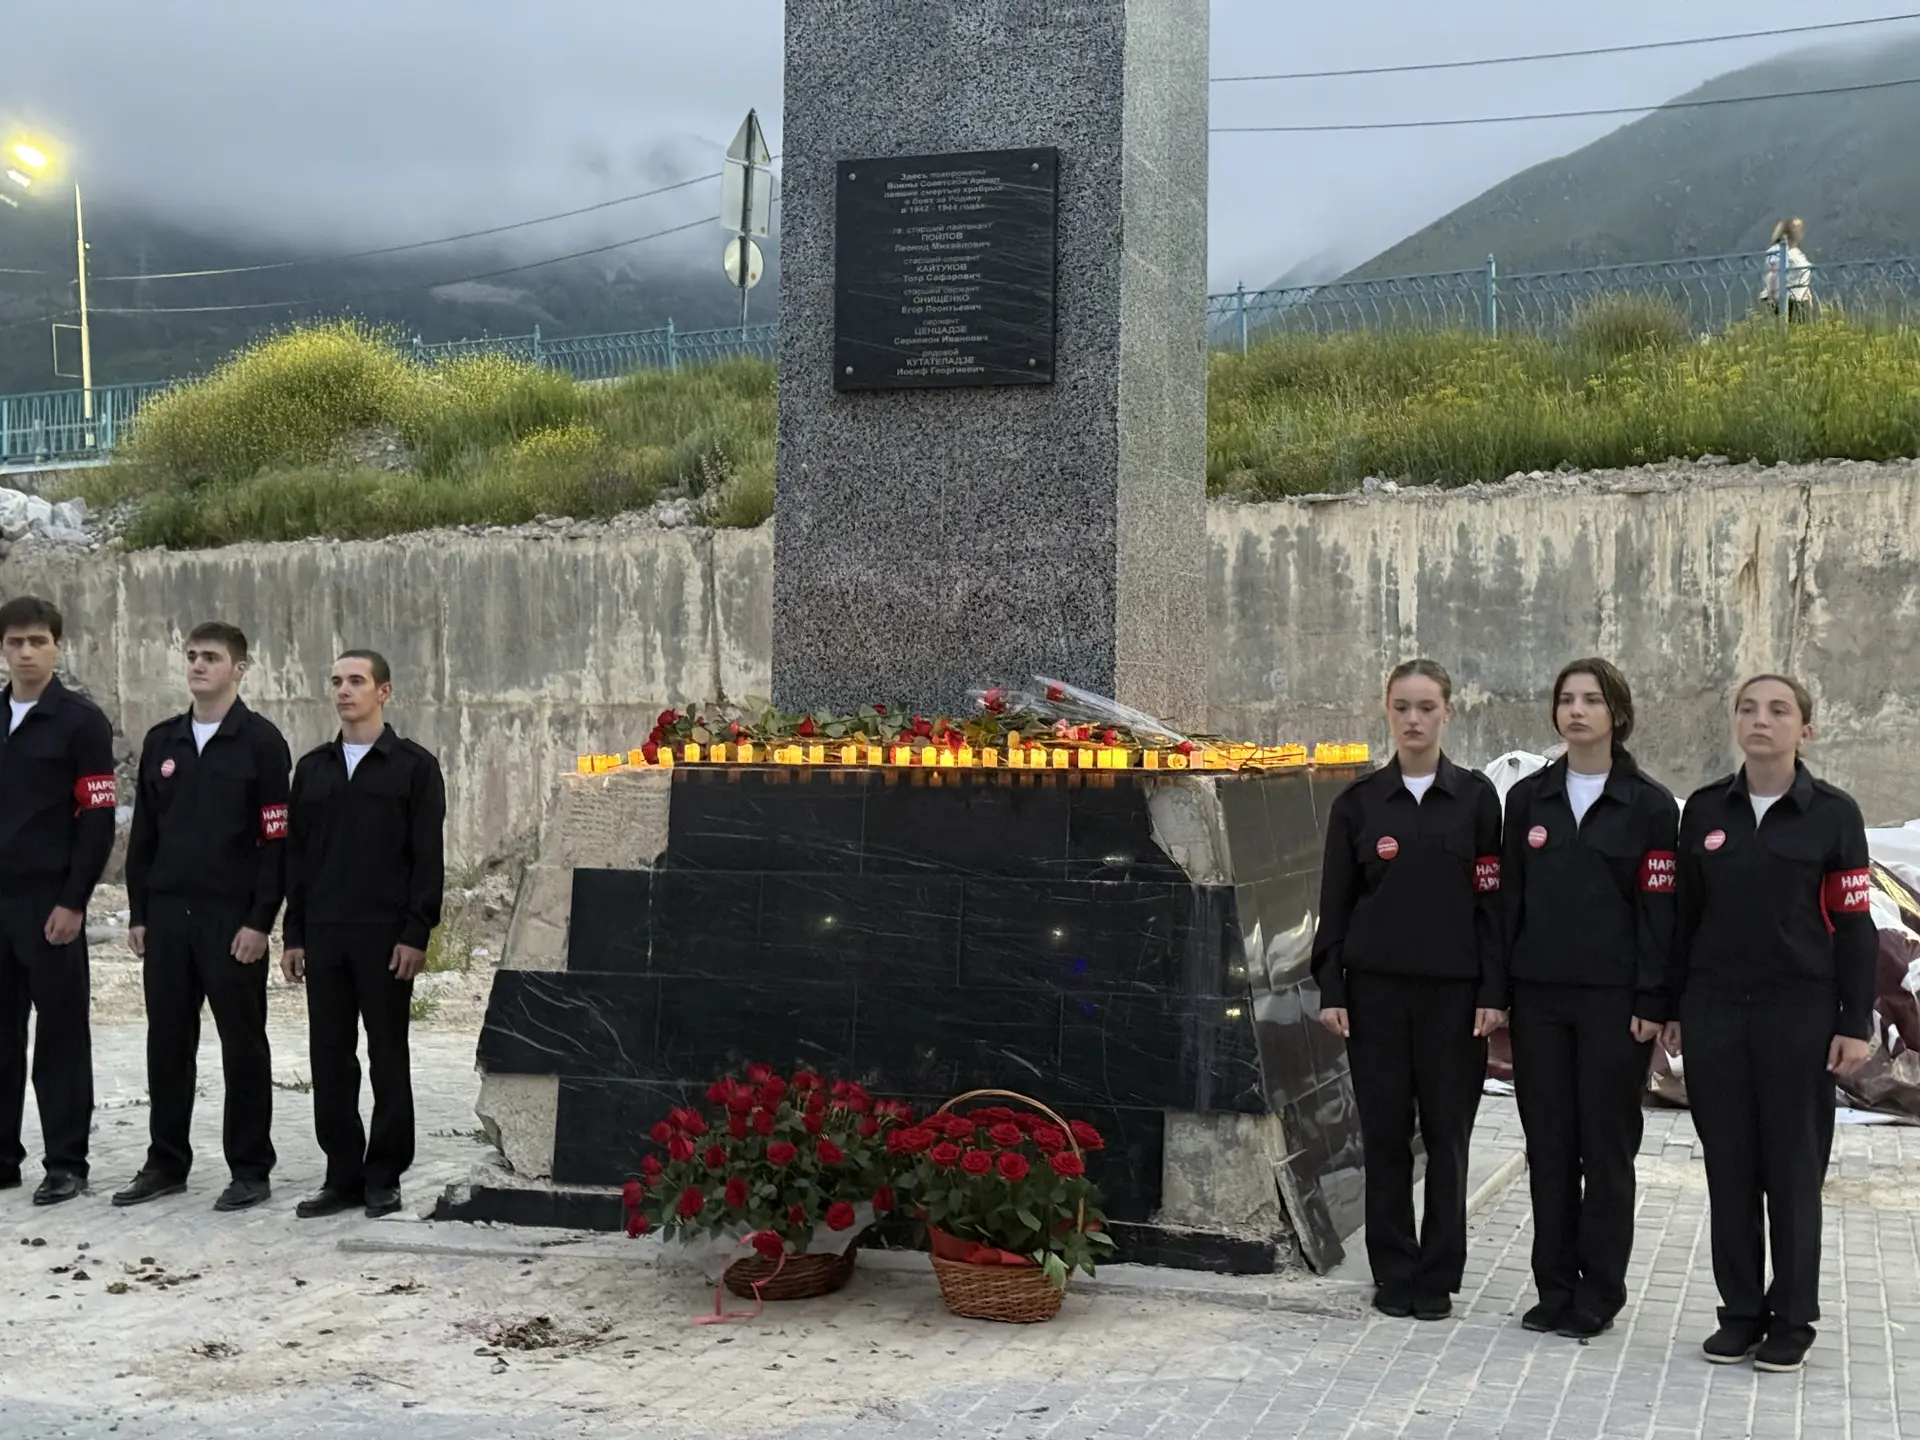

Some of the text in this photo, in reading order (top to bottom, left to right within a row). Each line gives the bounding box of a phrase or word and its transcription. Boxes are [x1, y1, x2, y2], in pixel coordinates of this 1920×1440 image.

[901, 172, 928, 181] Здесь
[887, 181, 918, 190] Воины
[913, 294, 970, 305] ОНИЩЕНКО
[906, 356, 975, 367] КУТАТЕЛАДЗЕ
